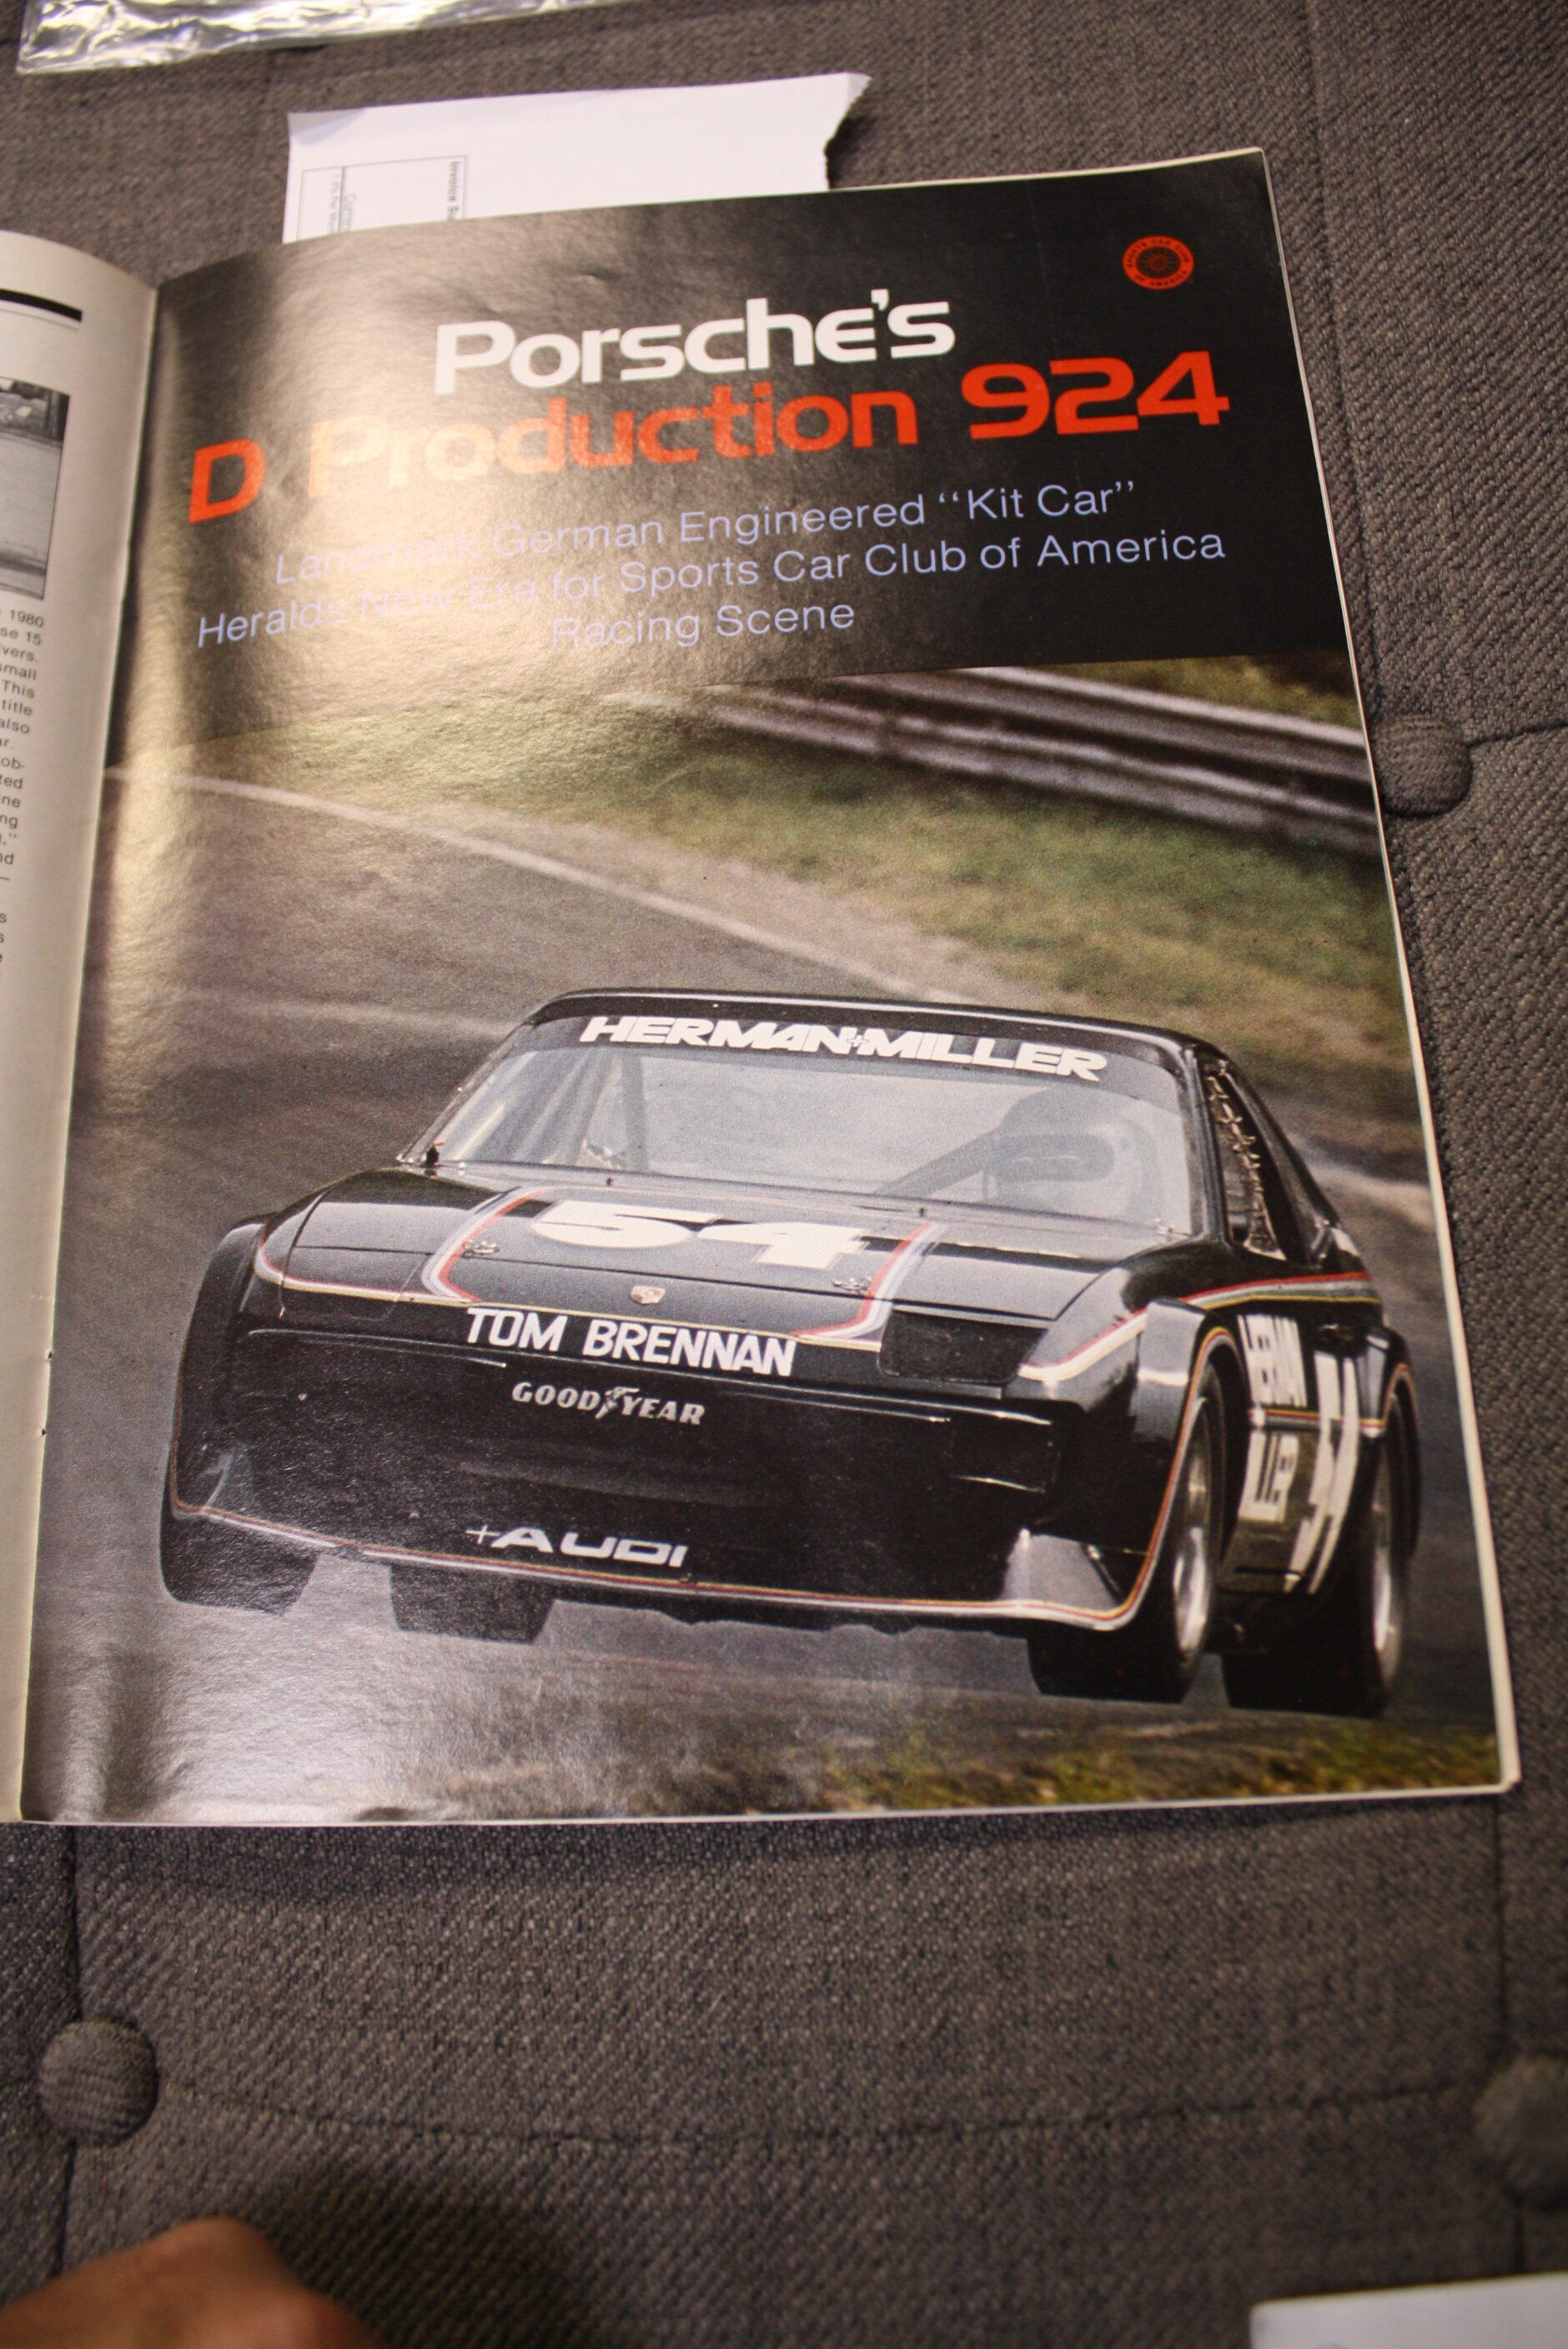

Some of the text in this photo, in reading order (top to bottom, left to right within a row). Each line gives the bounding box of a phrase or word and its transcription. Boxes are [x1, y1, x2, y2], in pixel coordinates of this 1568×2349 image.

[433, 289, 956, 395] Porsche's
[188, 350, 1230, 525] D Production 924
[275, 531, 477, 584] Landmark
[492, 520, 661, 559] German
[680, 494, 925, 545] Engineered
[197, 528, 1226, 647] Heralds New Era for Sports Car Club of America
[9, 610, 44, 626] 1980
[26, 631, 41, 646] 15
[552, 603, 855, 647] Racing Scene
[2, 680, 34, 698] This
[2, 700, 33, 716] title
[526, 1199, 865, 1270] 54
[466, 1307, 797, 1376] TOM BRENNAN
[511, 1381, 706, 1426] GOODYEAR
